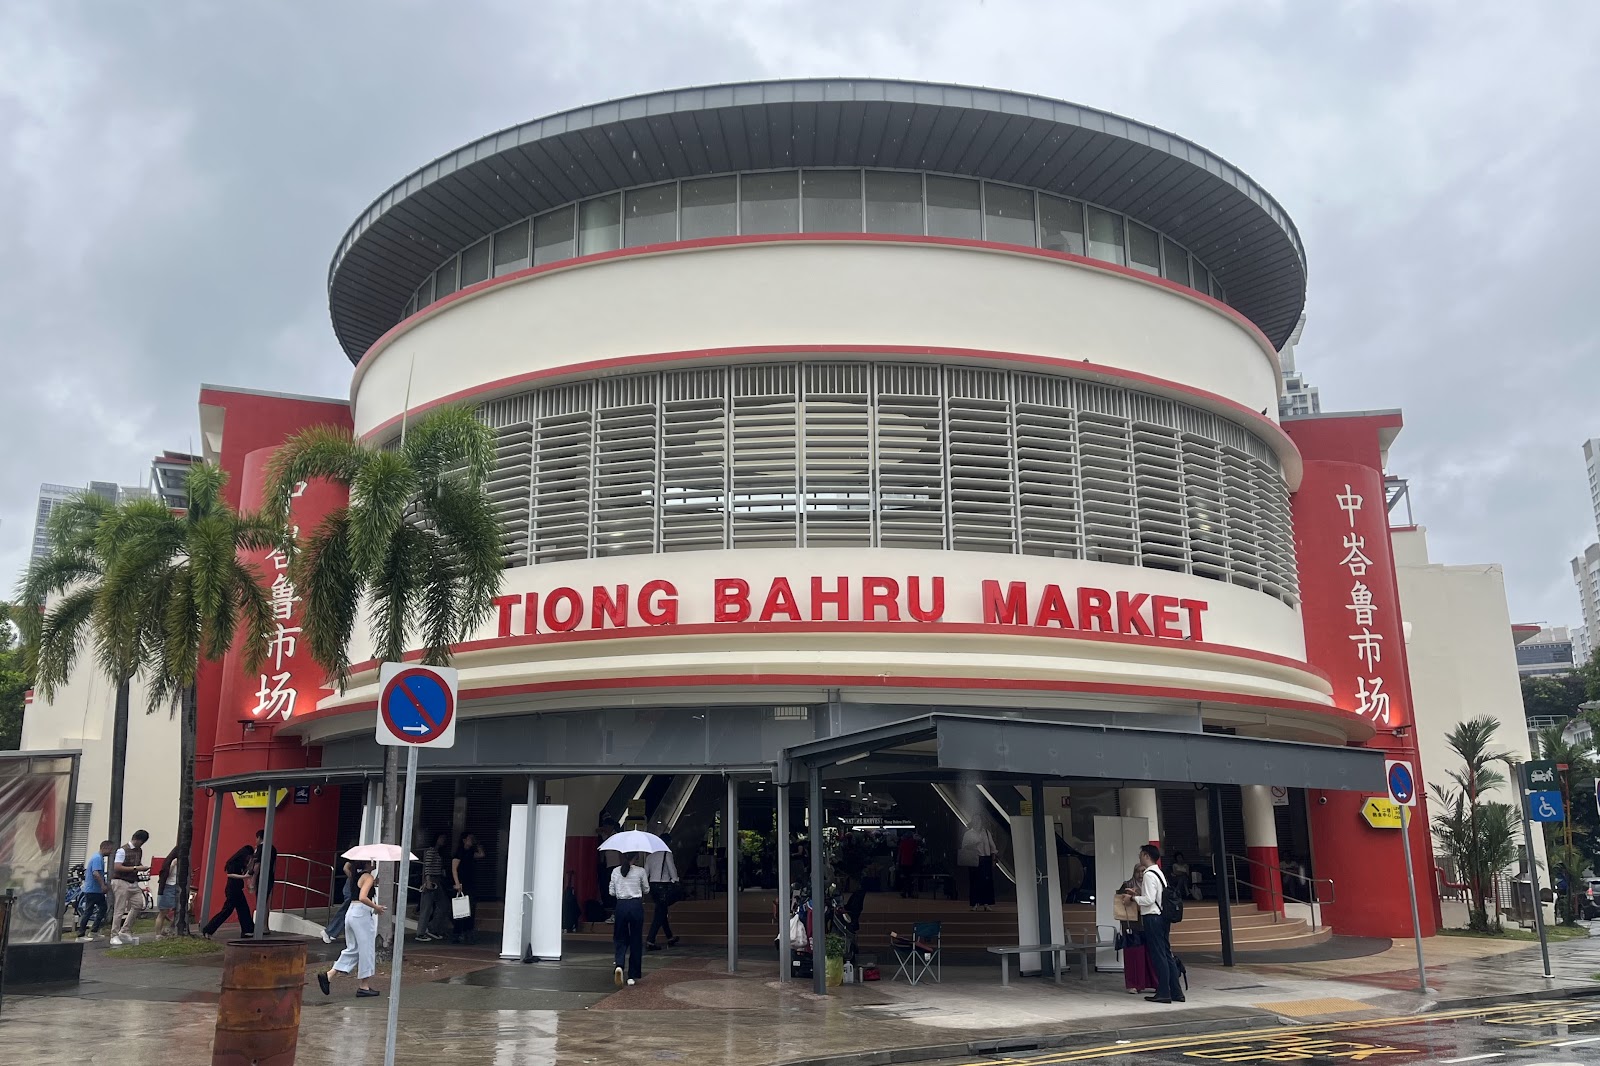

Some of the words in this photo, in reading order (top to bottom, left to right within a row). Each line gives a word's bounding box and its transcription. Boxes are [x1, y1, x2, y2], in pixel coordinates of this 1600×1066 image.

[491, 580, 679, 637] TIONG
[714, 575, 945, 623] BAHRU
[982, 579, 1208, 641] MARKET
[1335, 483, 1391, 724] 中峇鲁市场
